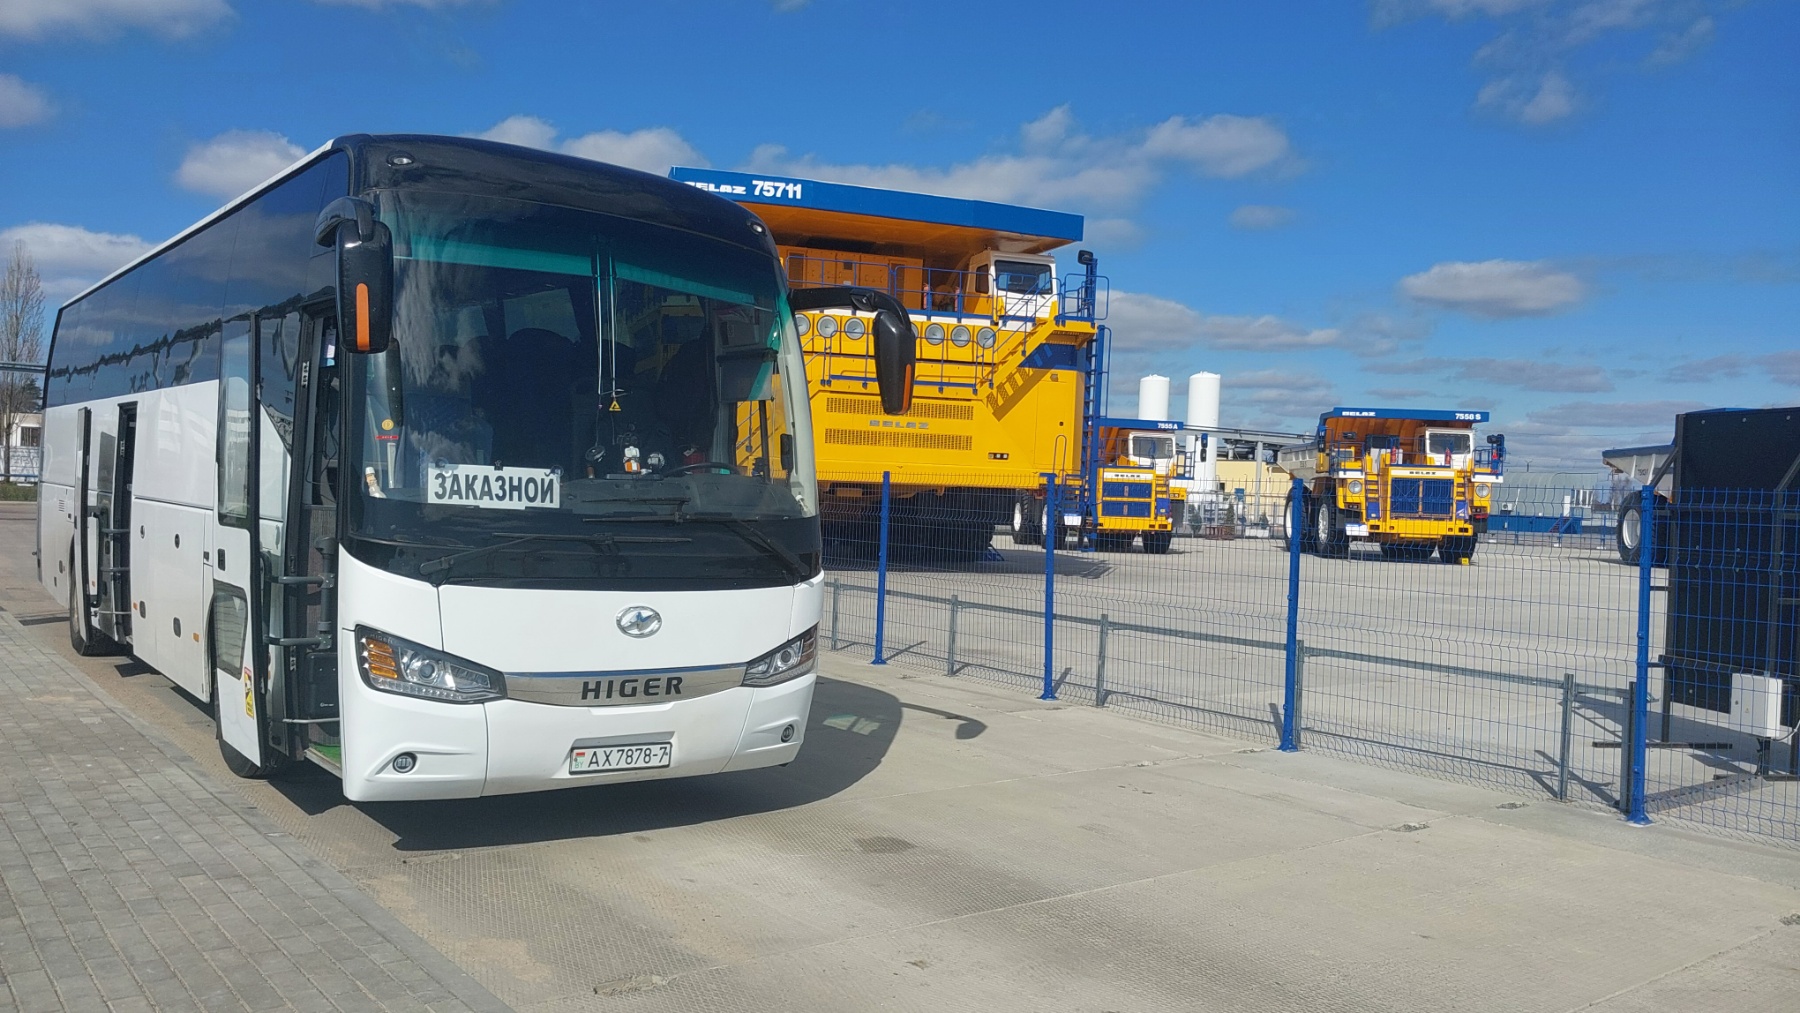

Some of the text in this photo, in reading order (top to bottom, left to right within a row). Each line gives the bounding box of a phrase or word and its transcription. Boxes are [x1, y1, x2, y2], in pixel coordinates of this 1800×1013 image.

[752, 180, 802, 199] 75711
[869, 419, 929, 429] BELAZ
[434, 471, 554, 504] ЗАКАЗНОЙ
[581, 676, 683, 700] HIGER
